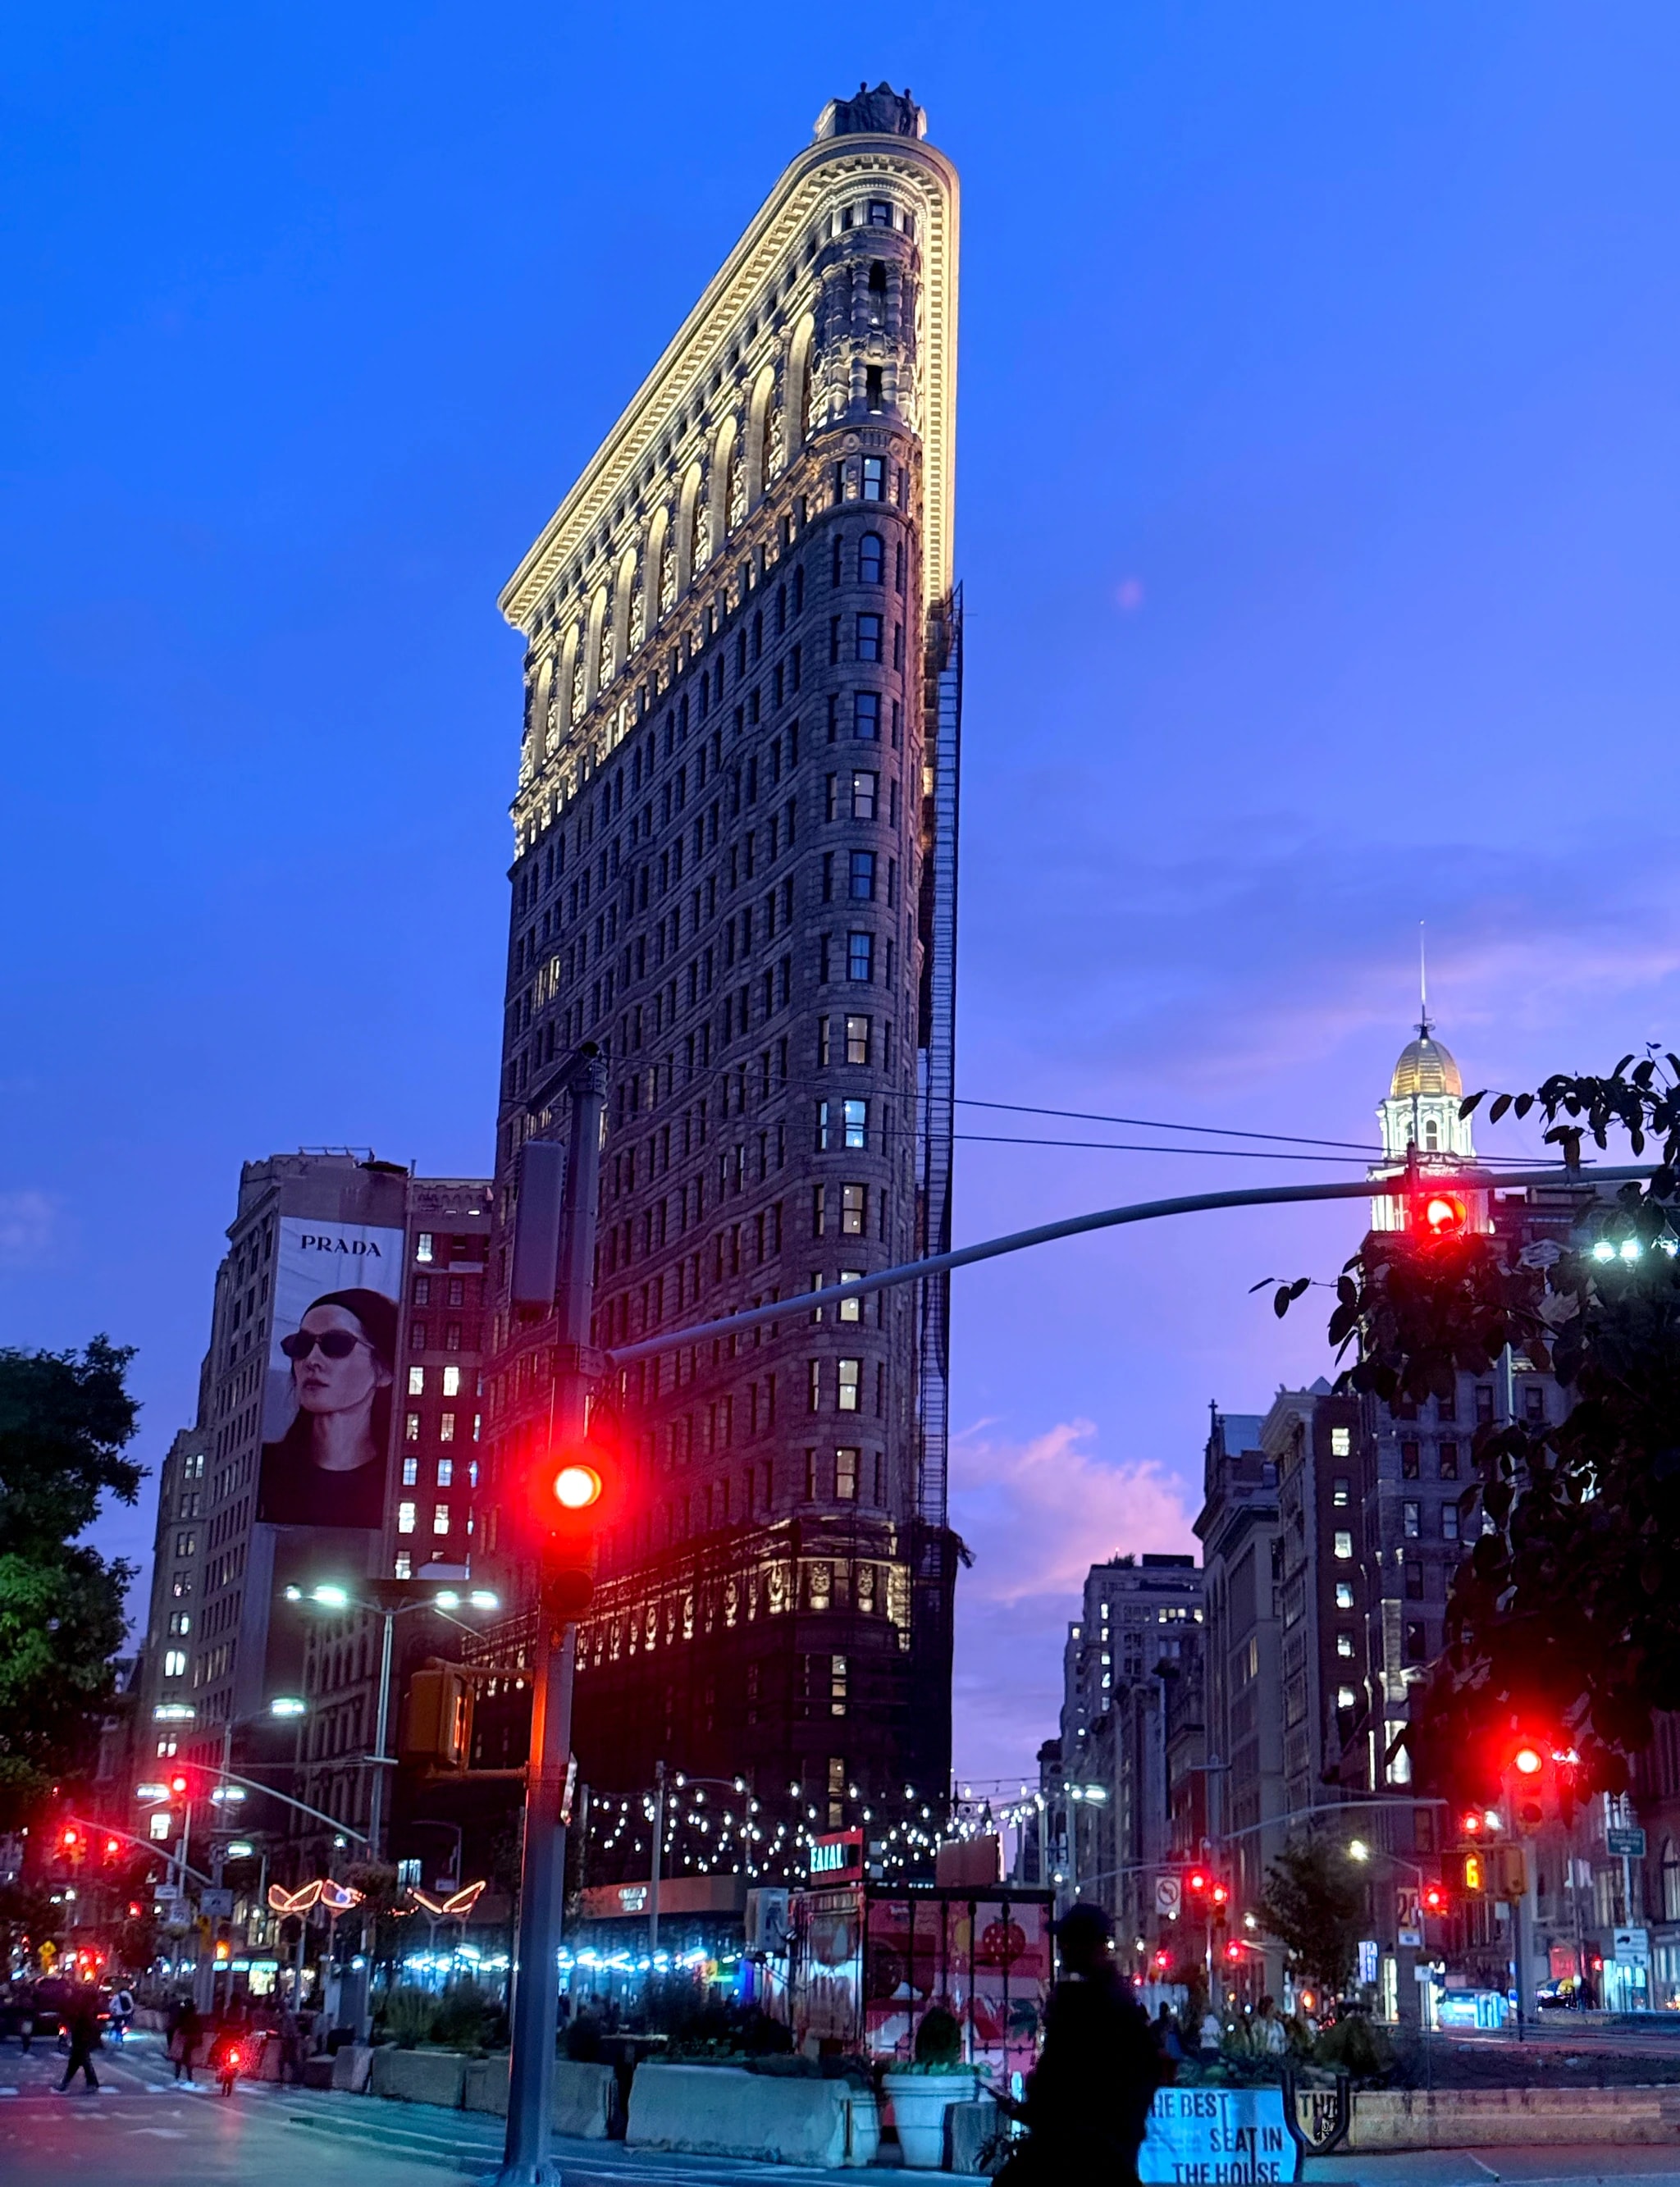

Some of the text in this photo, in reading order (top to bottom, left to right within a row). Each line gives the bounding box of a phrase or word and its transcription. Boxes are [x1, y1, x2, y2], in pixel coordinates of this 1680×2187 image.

[300, 1234, 381, 1258] PRADA
[1150, 2092, 1230, 2126] HE BEST
[1209, 2126, 1282, 2161] SEAT IN
[1171, 2161, 1281, 2185] THE HOUSE
